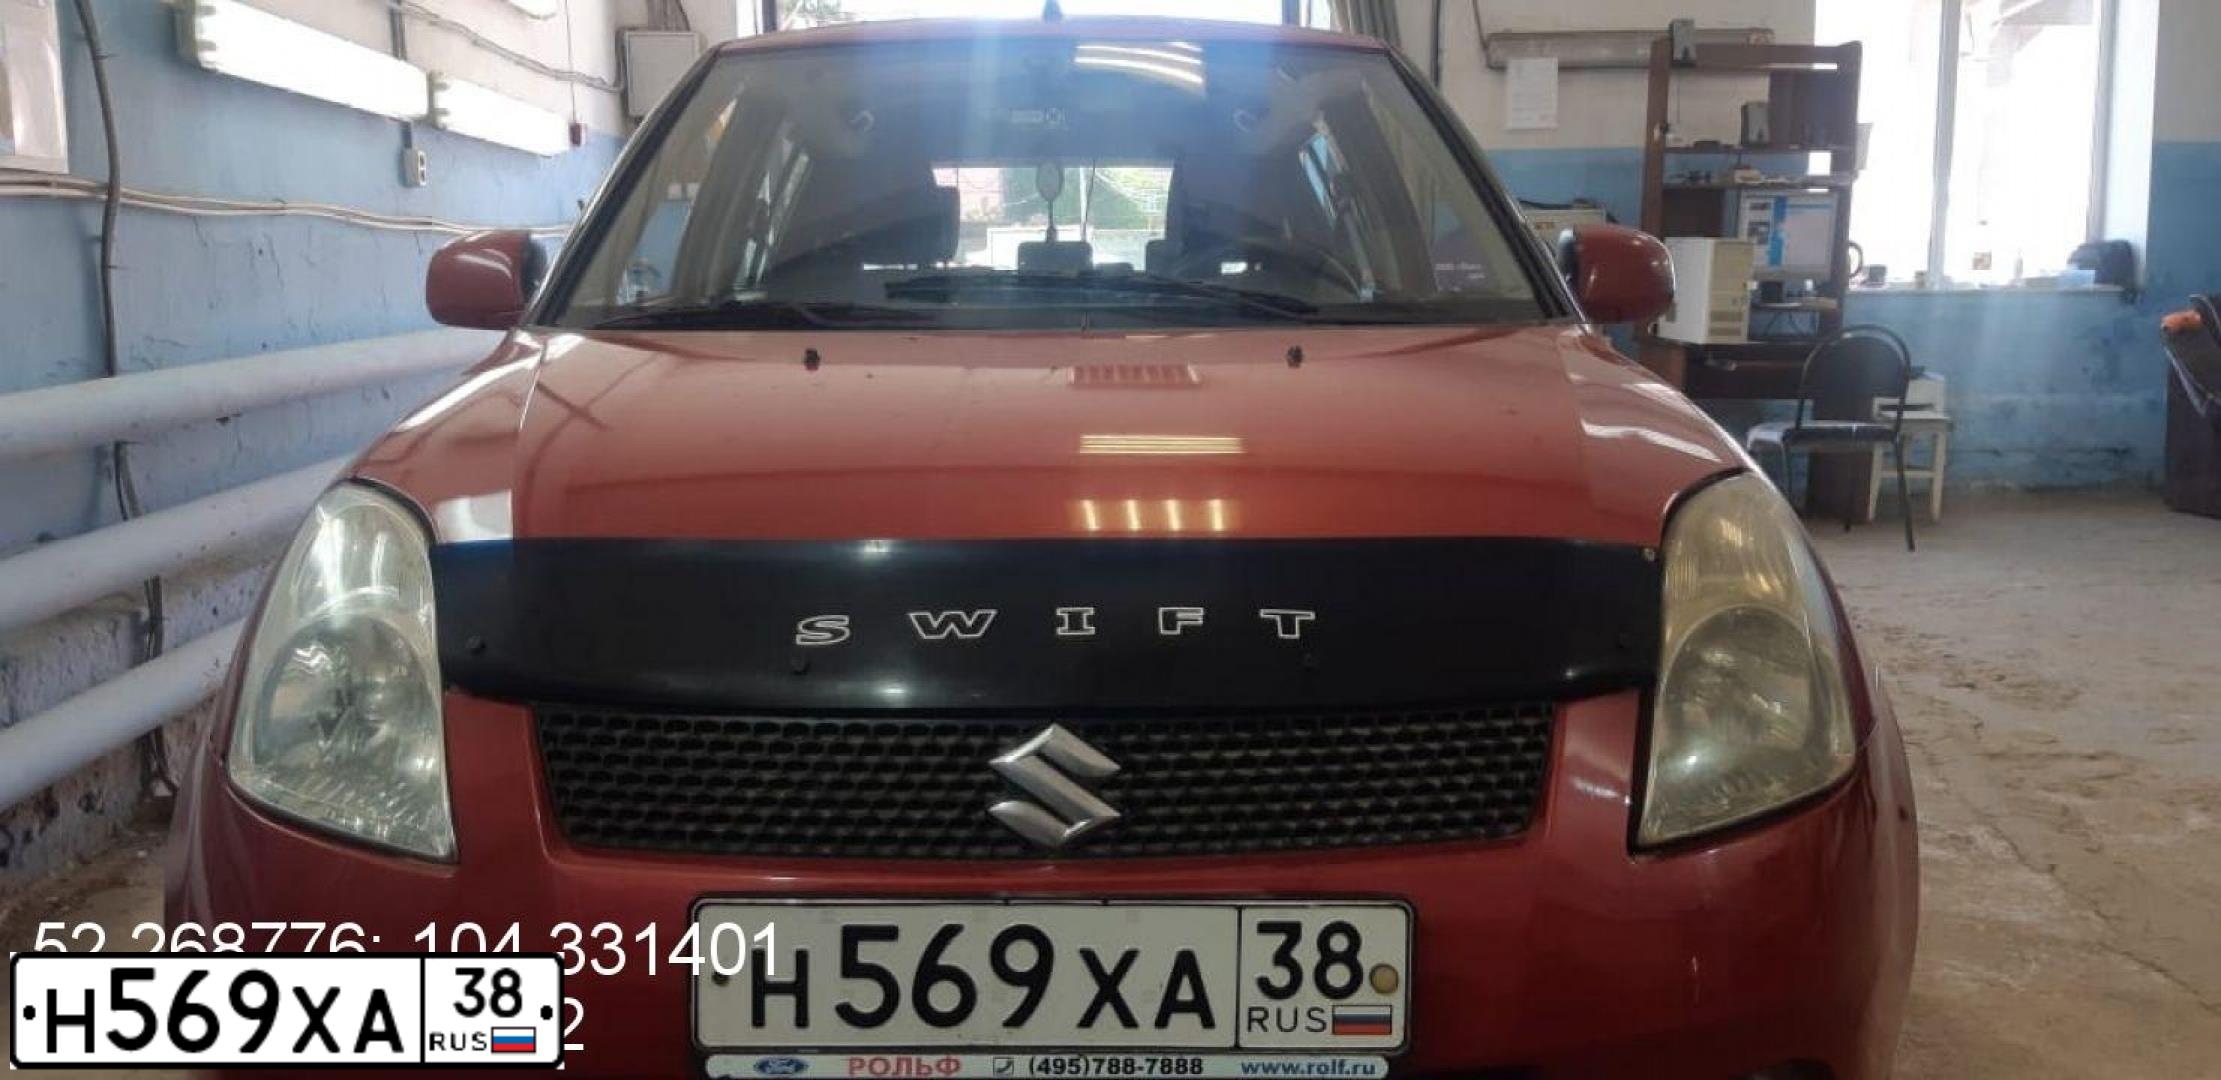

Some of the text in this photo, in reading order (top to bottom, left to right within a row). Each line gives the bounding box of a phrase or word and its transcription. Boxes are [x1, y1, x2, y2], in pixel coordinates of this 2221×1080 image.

[796, 606, 1316, 646] SWIFT
[1256, 920, 1364, 1001] 38
[1247, 1006, 1328, 1033] RUS
[848, 1056, 962, 1078] РОЛЬФ
[1240, 1058, 1376, 1076] www.rolf.ru
